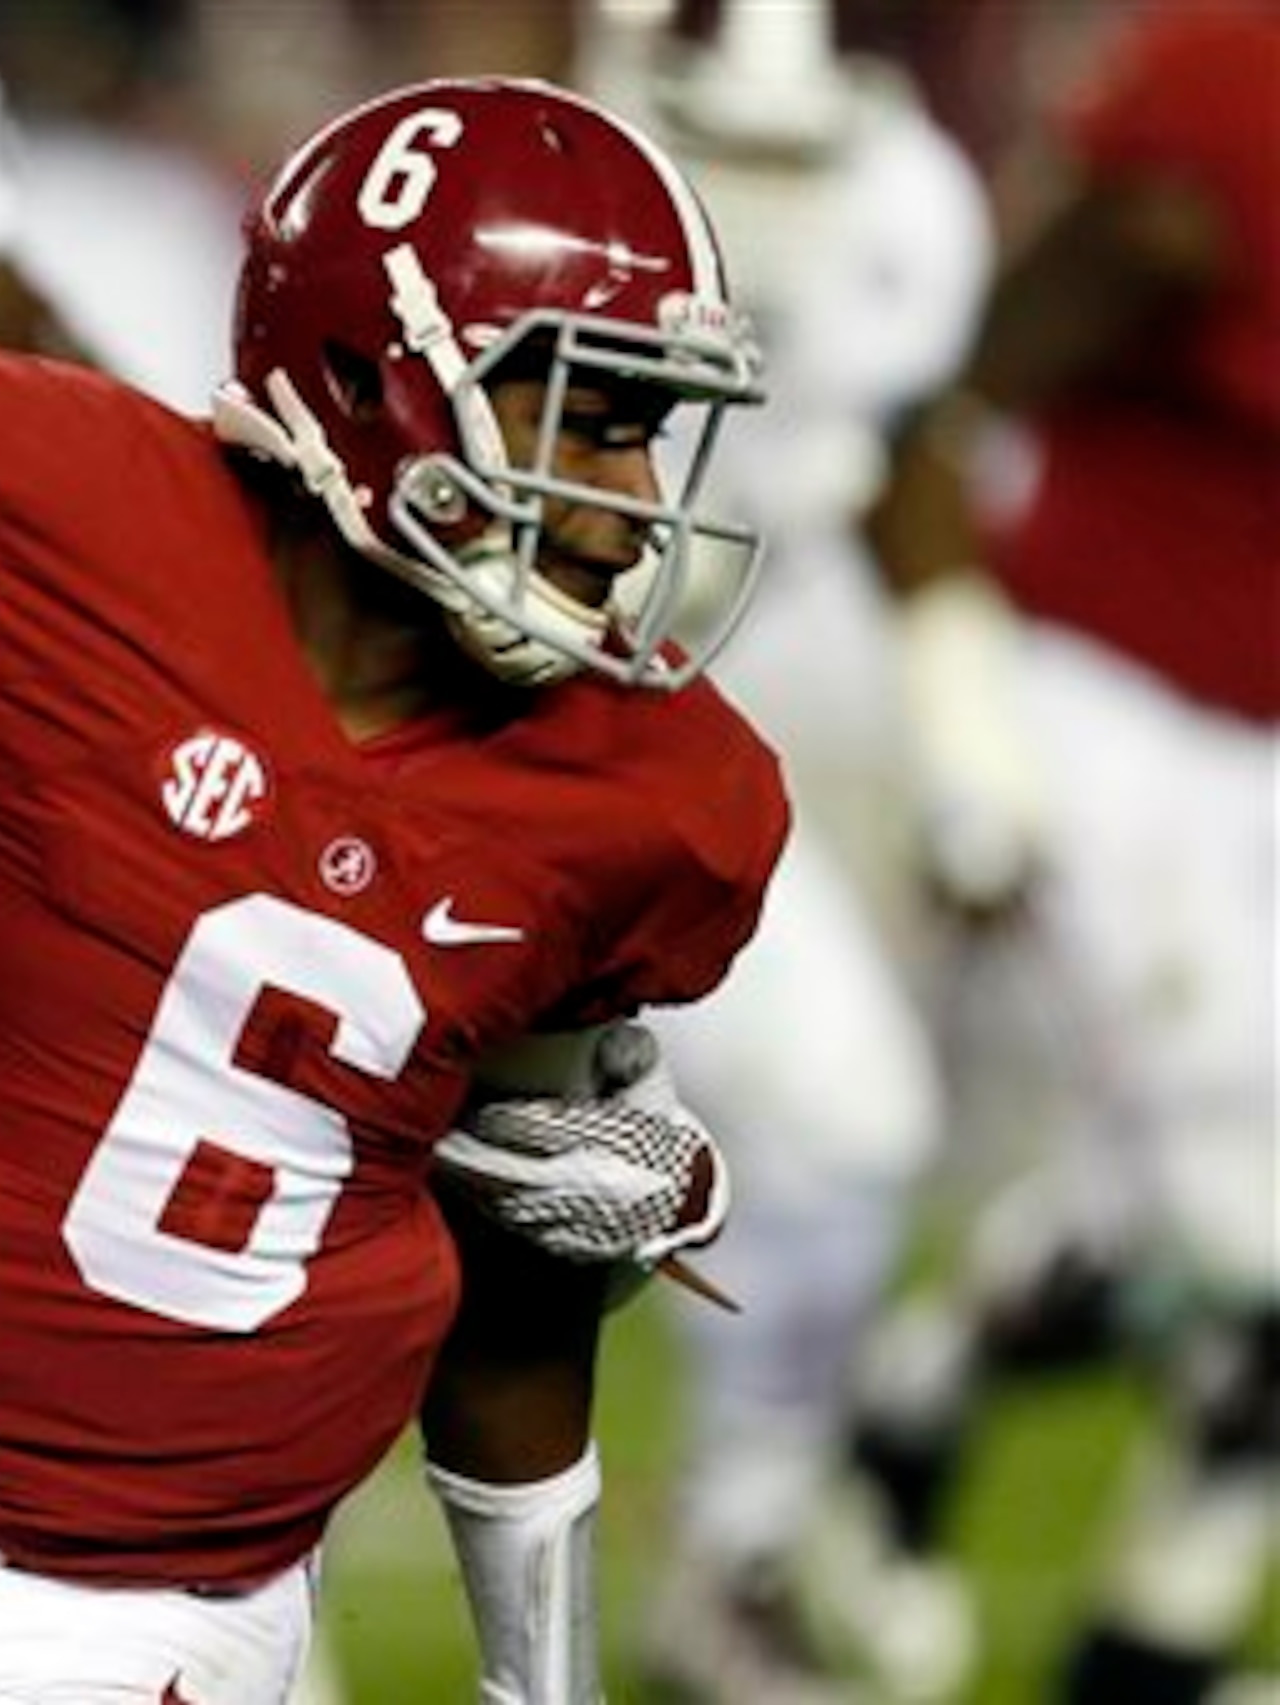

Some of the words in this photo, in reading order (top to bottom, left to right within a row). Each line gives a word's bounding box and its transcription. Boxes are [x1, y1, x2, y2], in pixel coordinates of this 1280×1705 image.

[357, 107, 465, 231] 6
[162, 733, 265, 841] SEC
[61, 892, 427, 1333] 6
